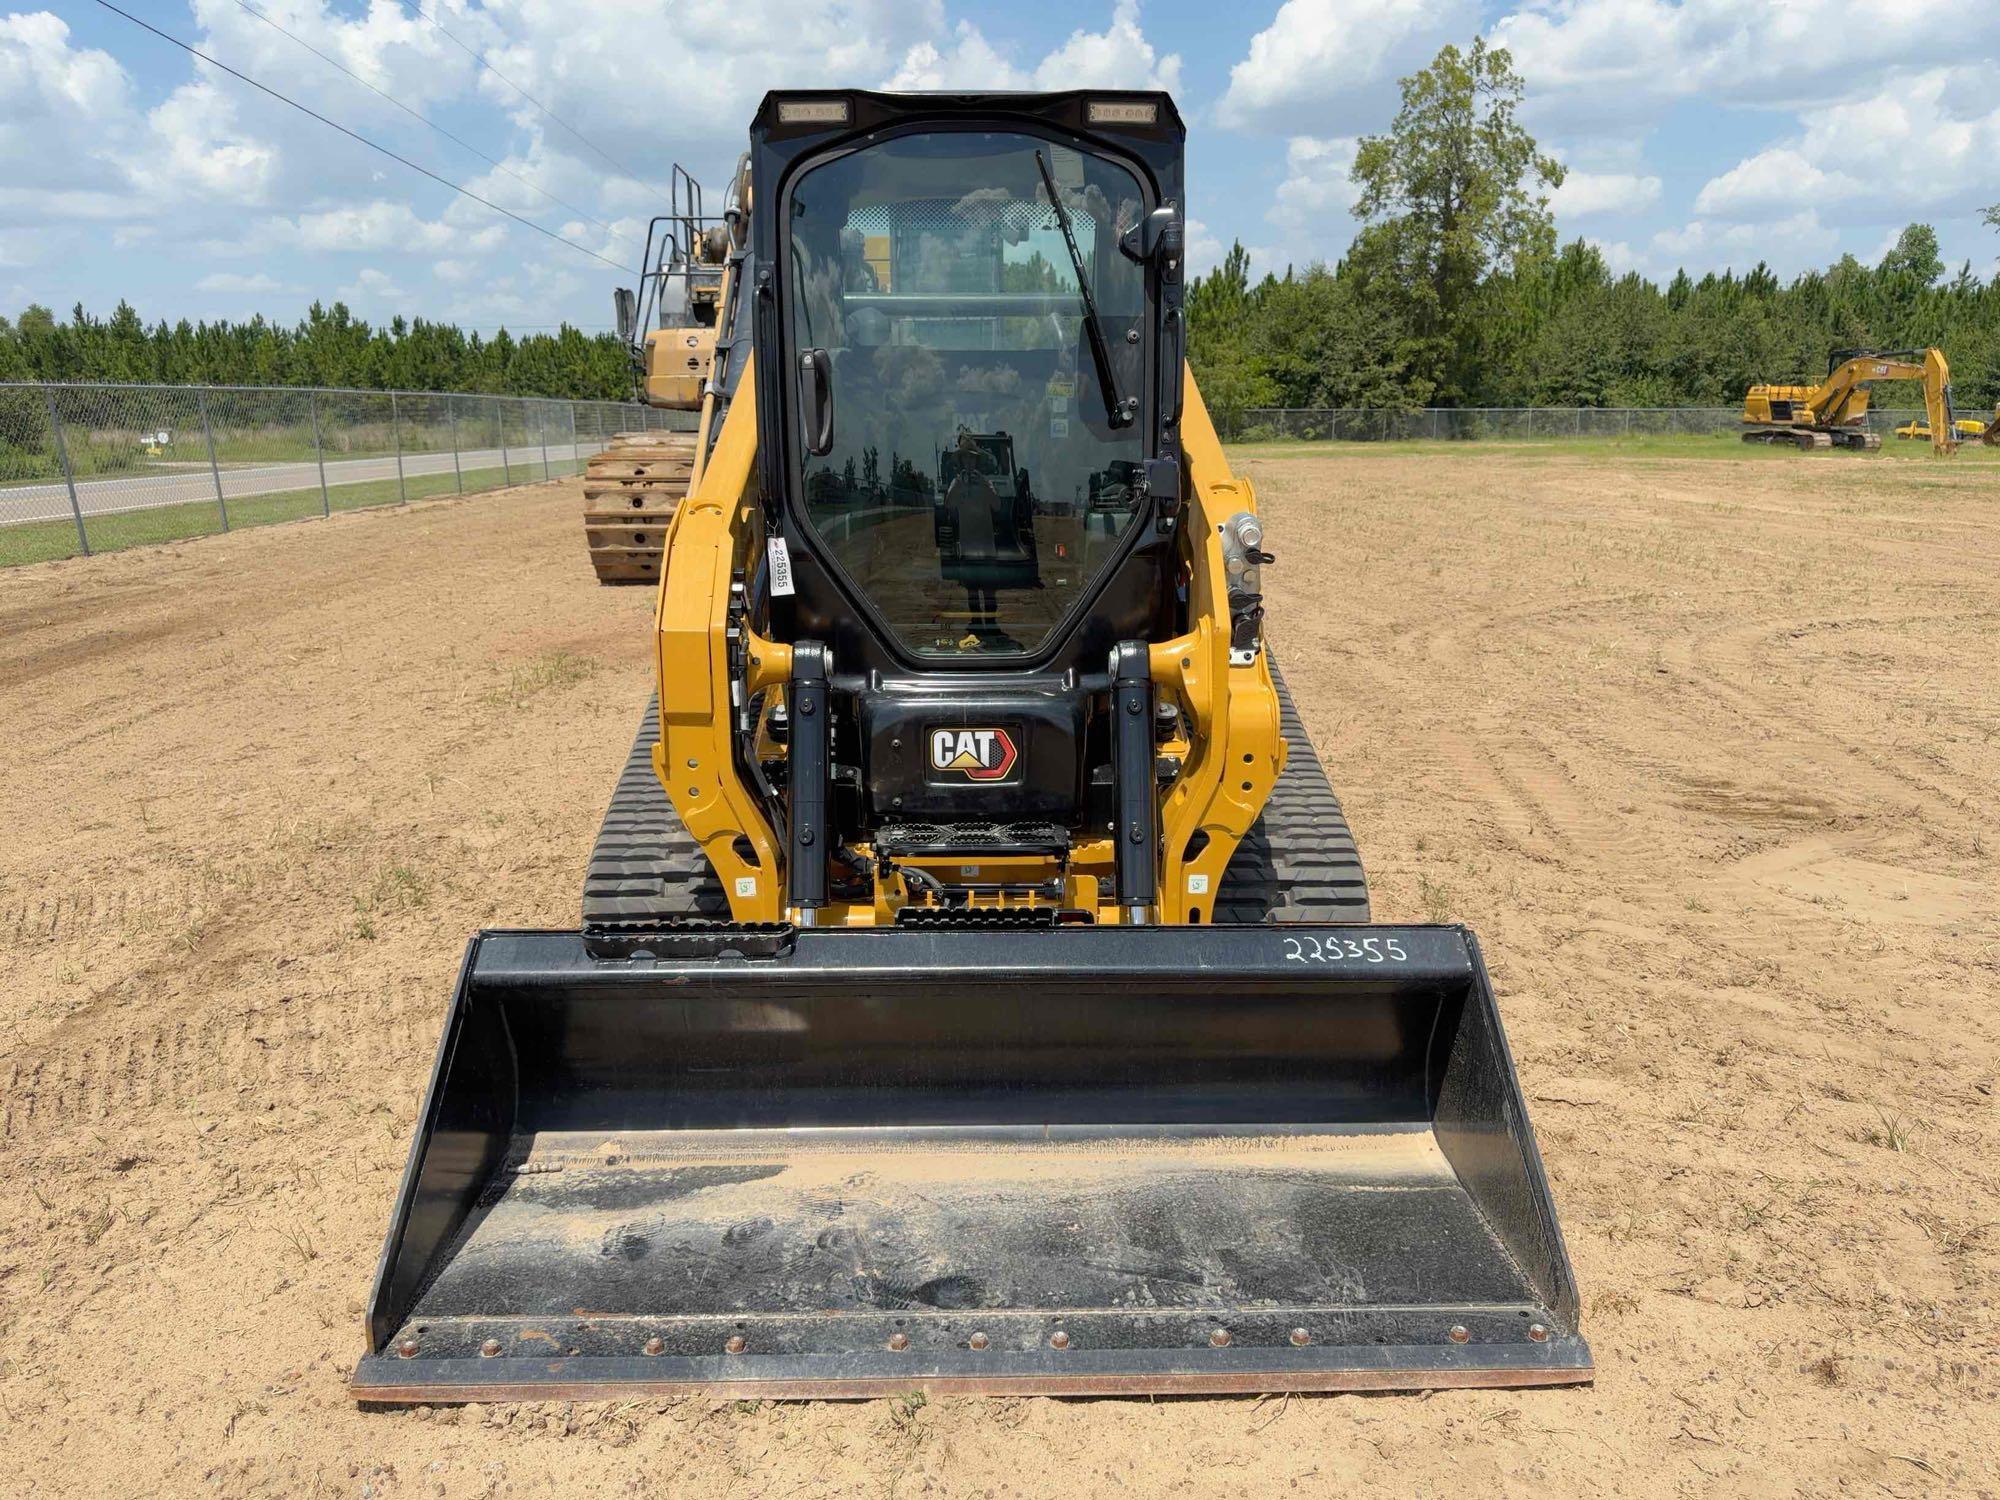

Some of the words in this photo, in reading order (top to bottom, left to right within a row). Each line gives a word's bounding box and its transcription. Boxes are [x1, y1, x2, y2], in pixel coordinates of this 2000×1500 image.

[774, 549, 788, 588] 225355
[933, 731, 995, 768] CAT
[1283, 936, 1408, 964] 225355
